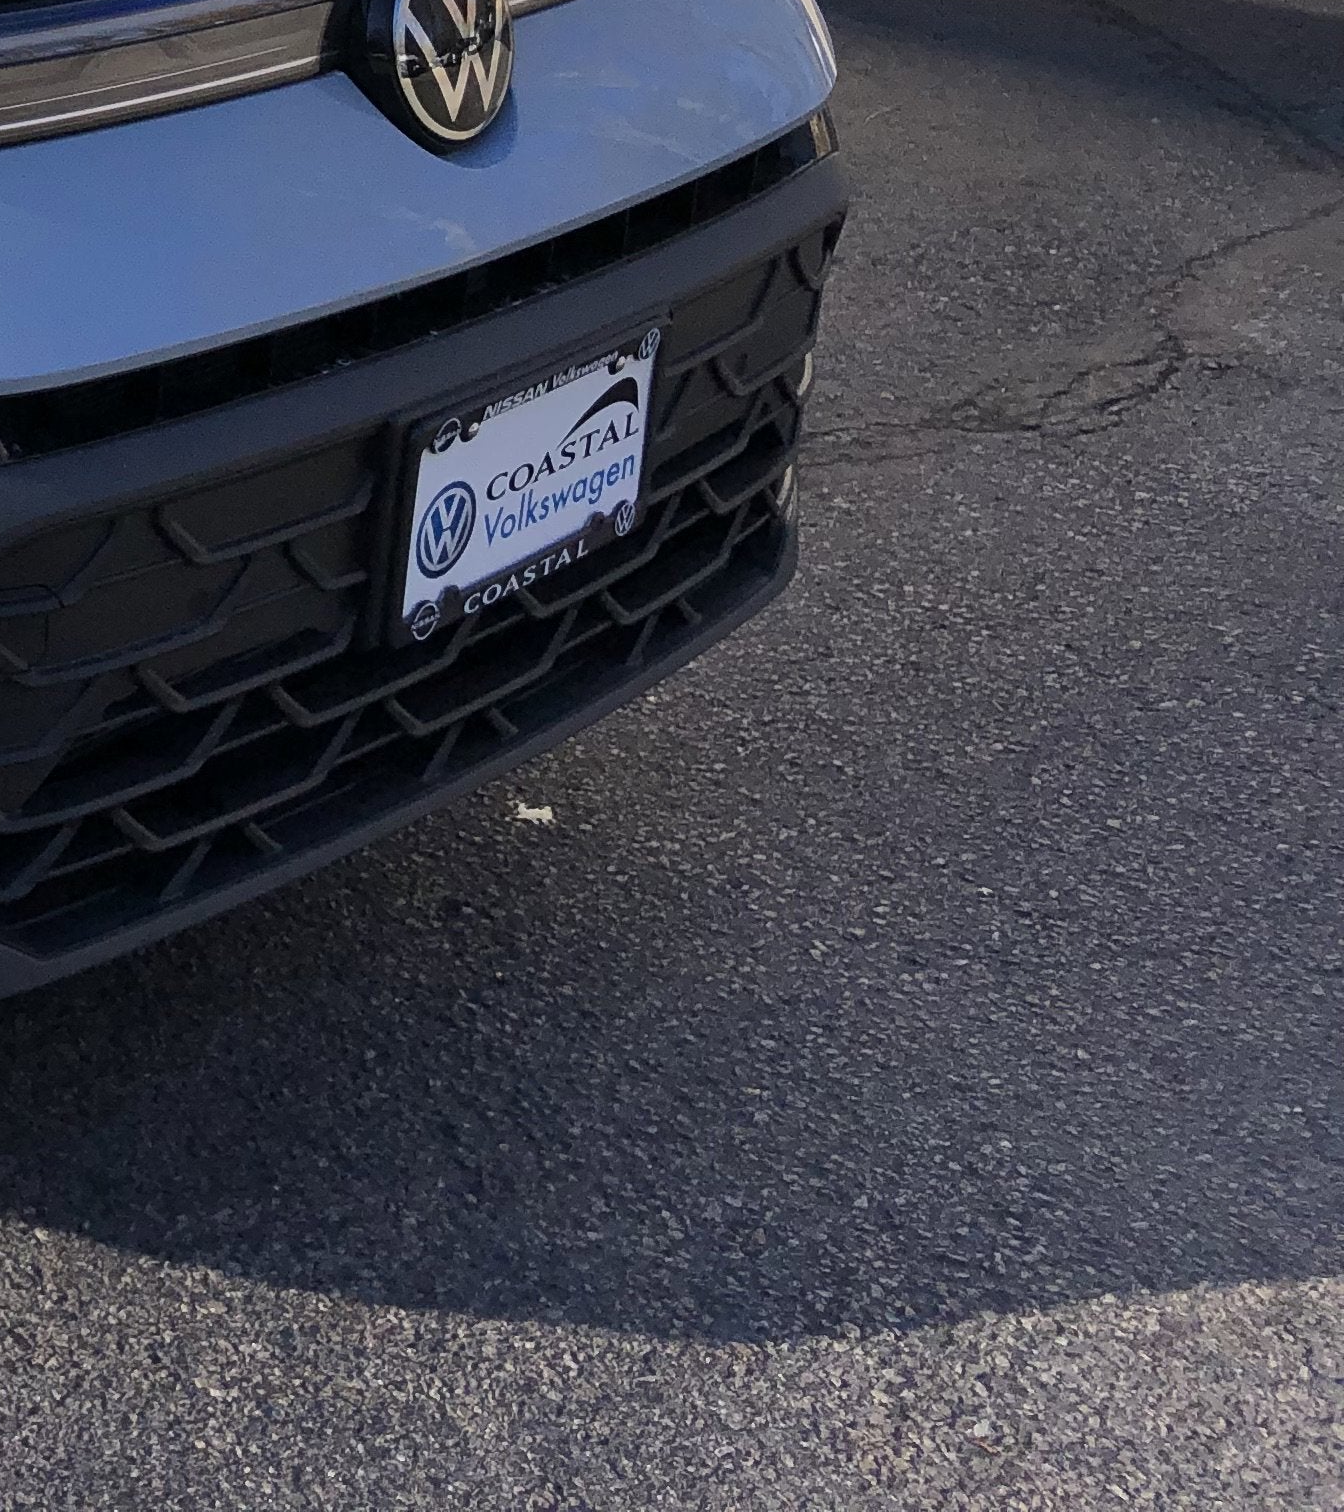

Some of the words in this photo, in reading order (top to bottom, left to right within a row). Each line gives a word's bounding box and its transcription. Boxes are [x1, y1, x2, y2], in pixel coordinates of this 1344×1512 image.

[482, 379, 549, 421] NISSAN
[486, 411, 639, 501] COASTAL
[483, 454, 635, 548] Volkswagen
[463, 538, 589, 614] COASTAL
